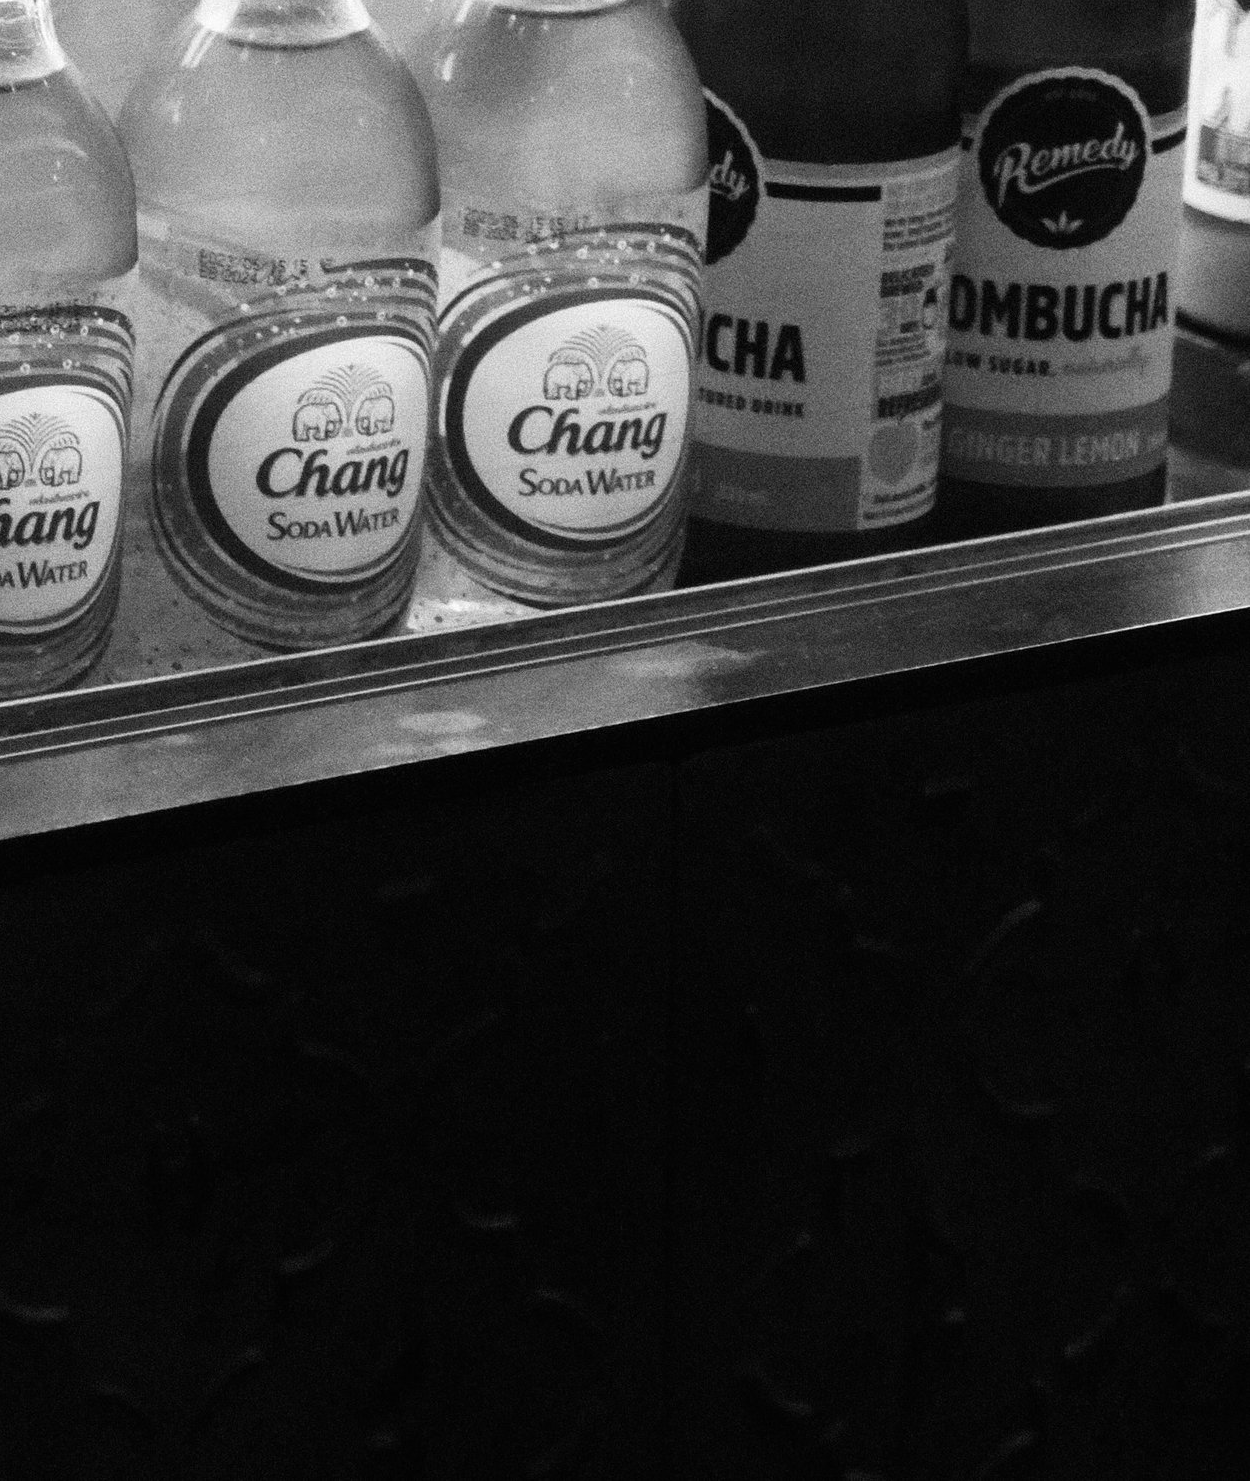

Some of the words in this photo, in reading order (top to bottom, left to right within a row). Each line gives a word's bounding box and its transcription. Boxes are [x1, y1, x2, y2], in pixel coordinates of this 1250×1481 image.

[993, 120, 1140, 209] Remedy
[948, 271, 1168, 342] OMBUCHA
[507, 405, 667, 460] Chang
[948, 426, 1051, 466] GINGER
[1058, 429, 1140, 467] LEMON
[256, 447, 409, 499] Chang
[518, 467, 584, 497] SODA
[586, 468, 655, 495] WATER
[267, 511, 332, 541] SODA
[334, 508, 401, 537] WATER
[17, 560, 88, 589] WATER
